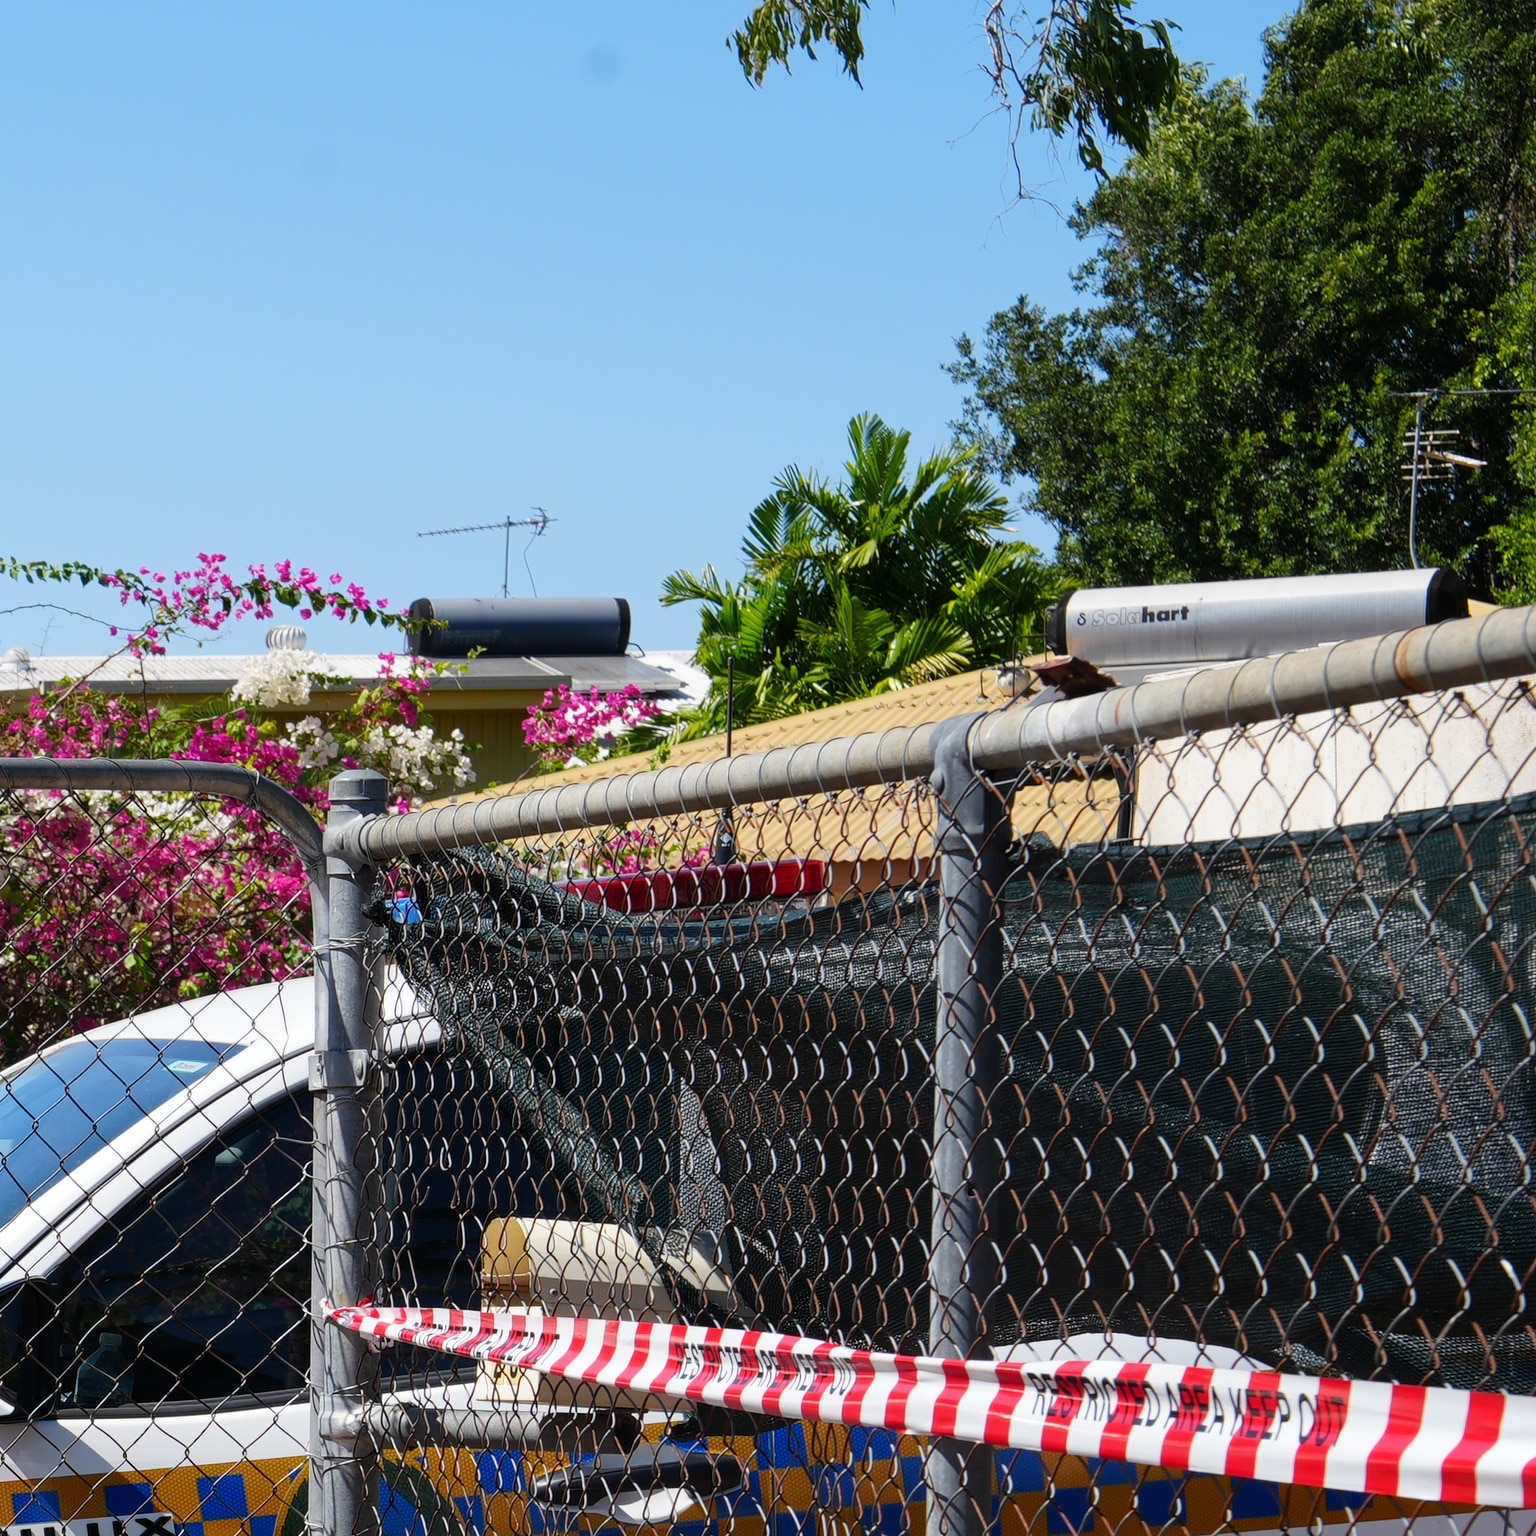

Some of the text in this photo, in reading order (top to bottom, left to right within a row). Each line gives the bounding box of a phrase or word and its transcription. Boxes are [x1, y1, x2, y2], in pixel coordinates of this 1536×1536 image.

[1092, 606, 1189, 626] Solahart
[674, 1342, 858, 1396] RESTRICTED AREA KEEP OUT
[1027, 1372, 1345, 1447] RESTRICTED AREA KEEP OUT
